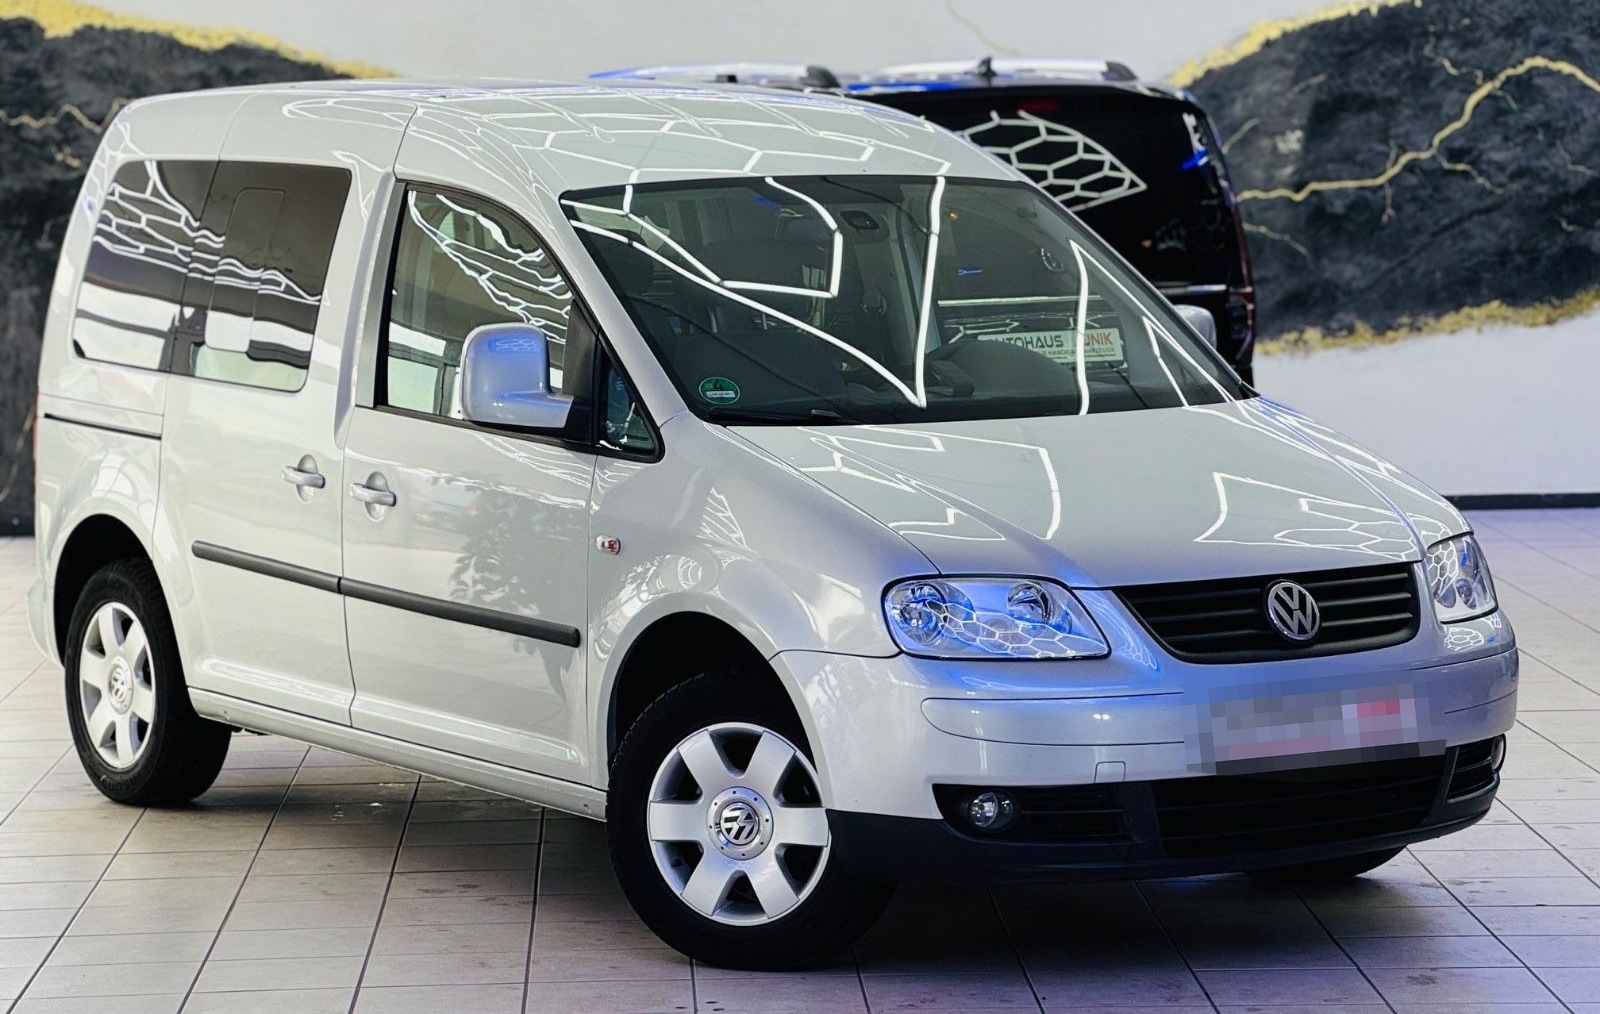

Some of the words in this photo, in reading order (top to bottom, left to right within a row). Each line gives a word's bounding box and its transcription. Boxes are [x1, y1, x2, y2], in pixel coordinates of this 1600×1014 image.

[989, 335, 1064, 349] TOHAUS
[1268, 582, 1320, 640] VW
[720, 801, 759, 846] VW
